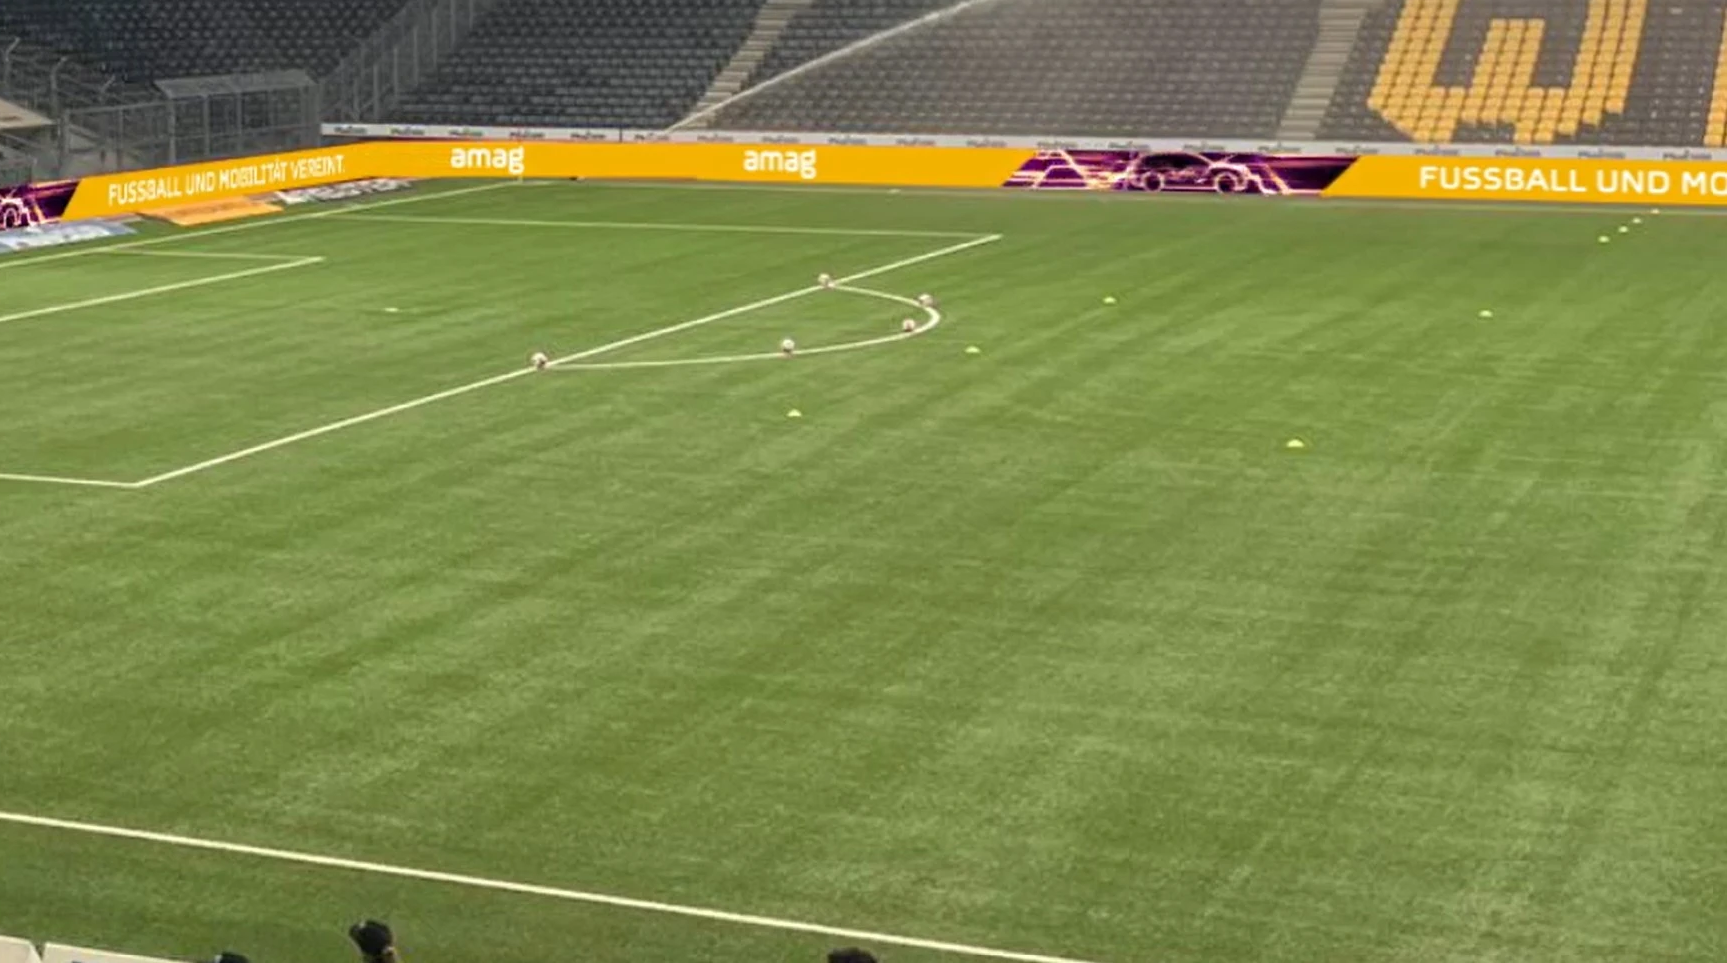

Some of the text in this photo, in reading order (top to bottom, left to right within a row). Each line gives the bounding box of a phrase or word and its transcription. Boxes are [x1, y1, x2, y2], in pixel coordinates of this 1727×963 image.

[450, 145, 525, 174] amag
[743, 148, 817, 179] amag
[108, 175, 182, 206] FUSSBALL
[185, 171, 215, 195] UND
[219, 157, 287, 189] MOBILITÄT
[1419, 165, 1587, 193] FUSSBALL
[1597, 168, 1670, 195] UND
